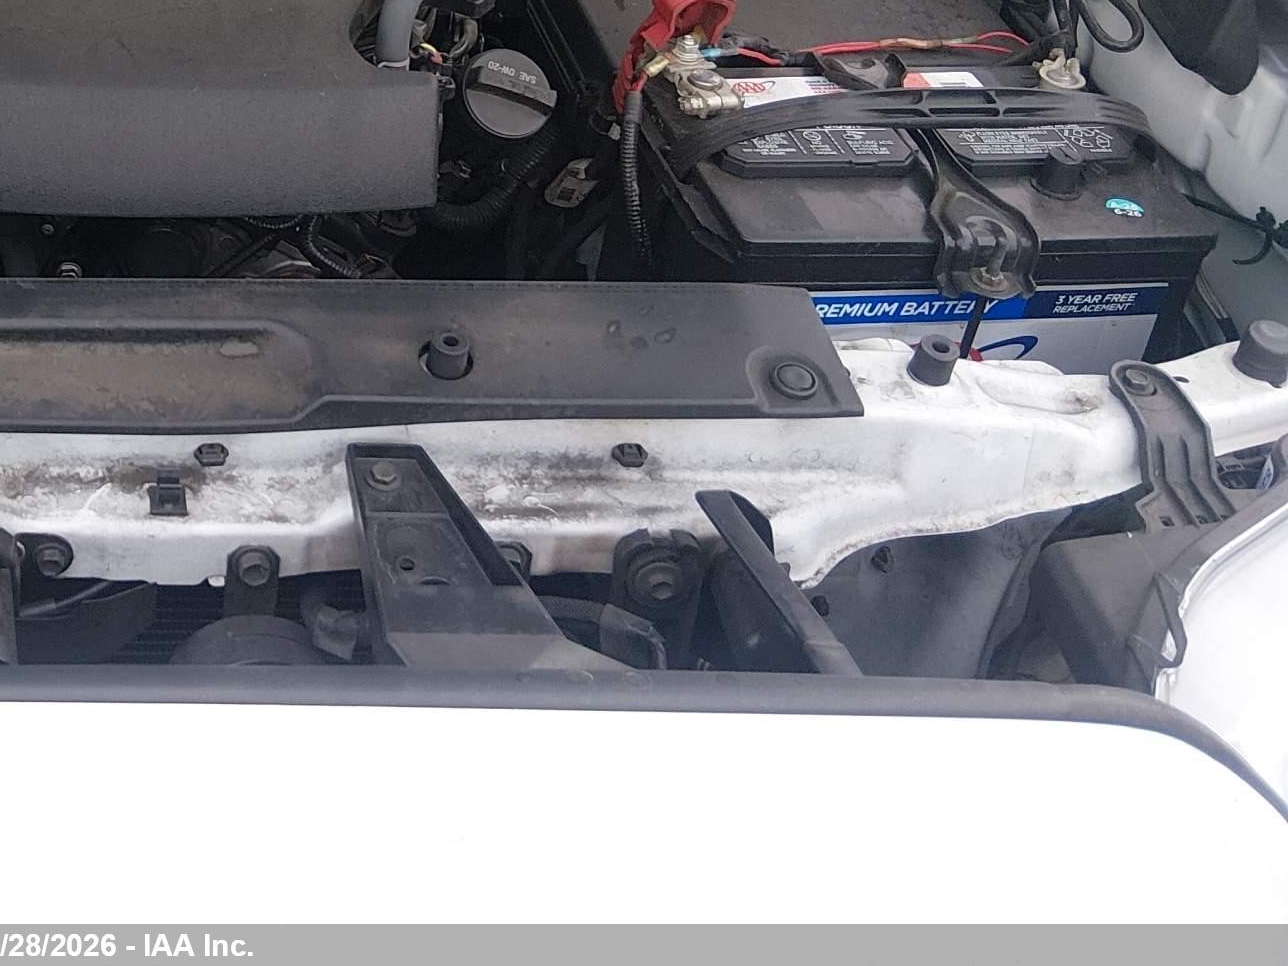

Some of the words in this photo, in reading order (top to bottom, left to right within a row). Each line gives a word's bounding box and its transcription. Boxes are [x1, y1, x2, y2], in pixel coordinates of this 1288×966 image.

[487, 60, 516, 77] 0W-20
[519, 71, 537, 85] SAE
[1056, 295, 1066, 305] 3
[1068, 294, 1102, 305] YEAR
[1102, 292, 1139, 303] FREE
[816, 302, 896, 318] REMIUM
[1052, 302, 1133, 314] REPLACEMENT
